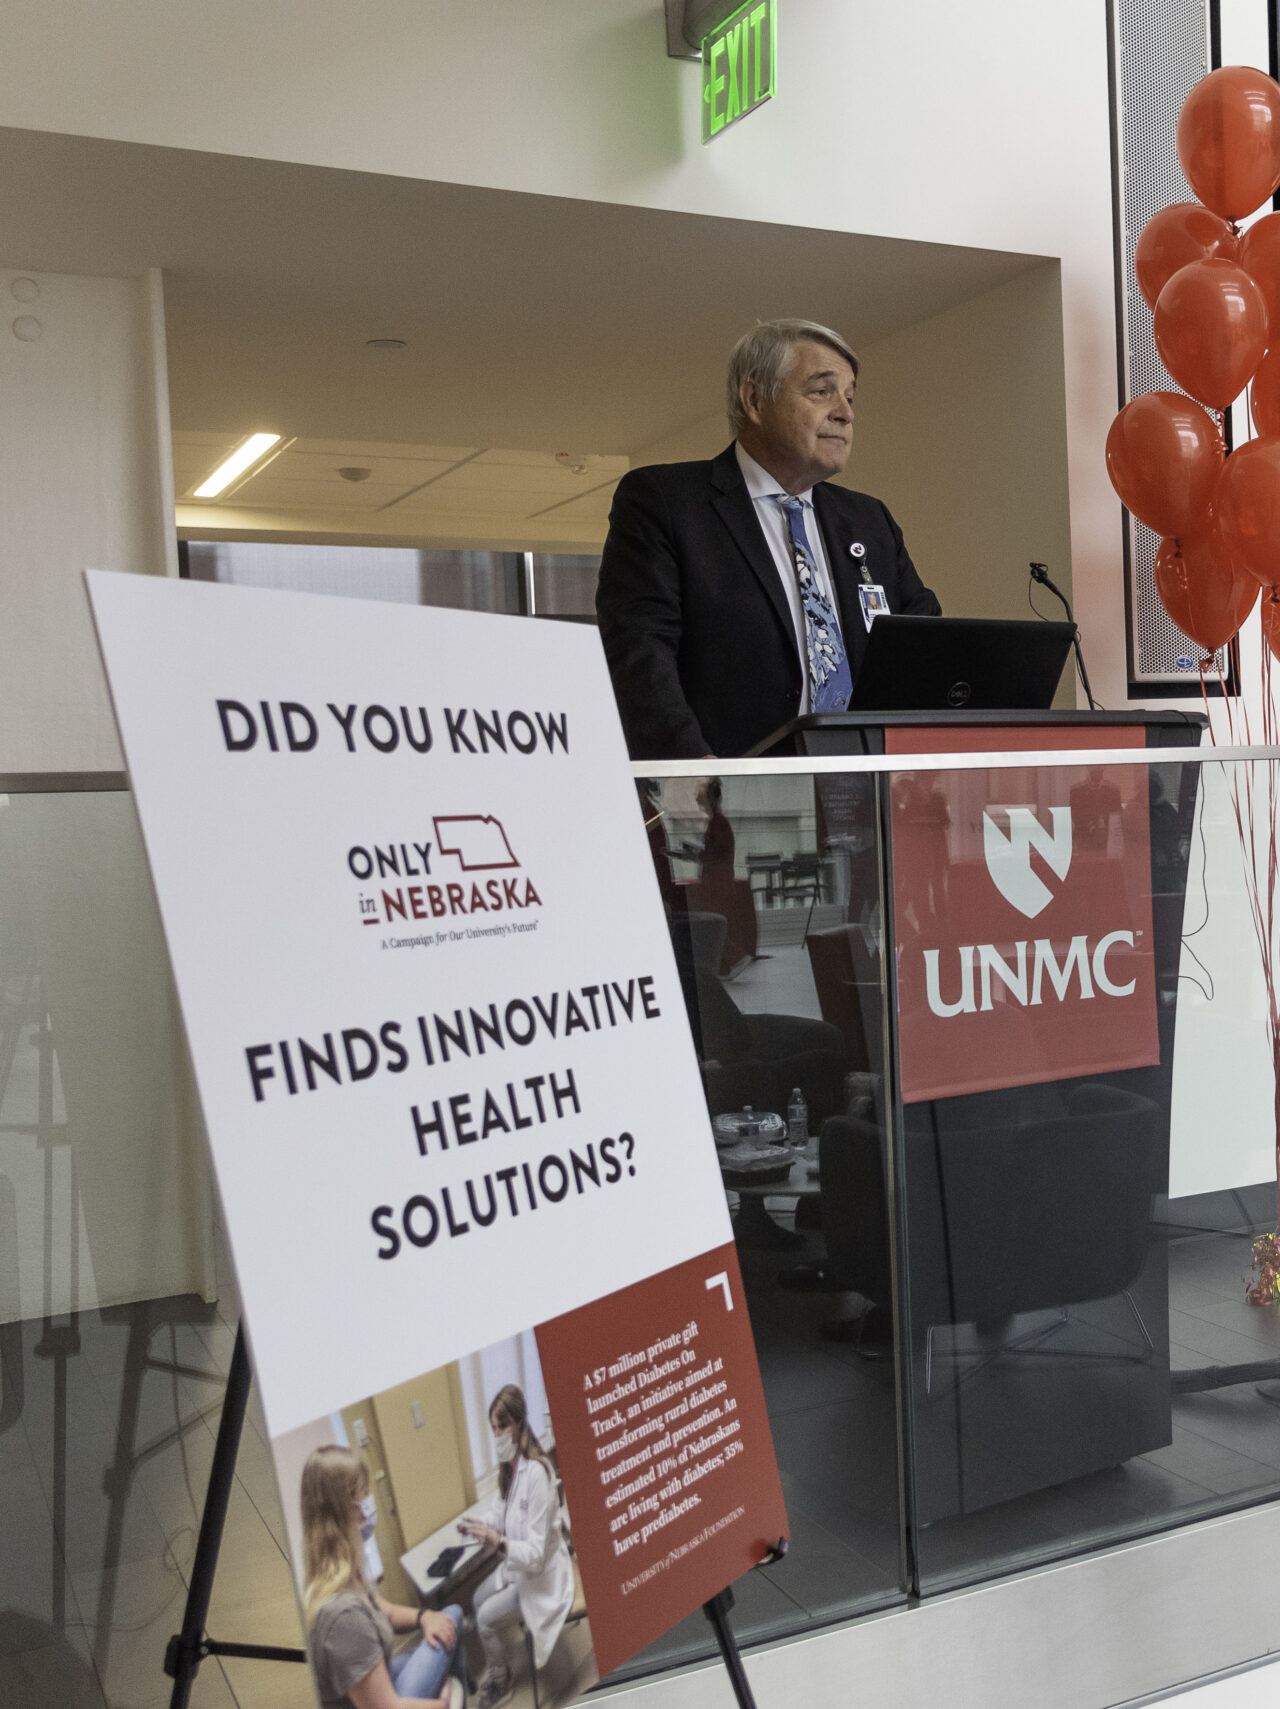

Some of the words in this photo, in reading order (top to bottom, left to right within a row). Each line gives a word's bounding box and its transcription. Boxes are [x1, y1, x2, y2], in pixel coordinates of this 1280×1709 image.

[710, 2, 766, 135] EXIT
[215, 699, 319, 753] DID
[326, 702, 434, 754] YOU
[443, 707, 570, 756] KNOW
[347, 842, 432, 880] ONLY
[359, 893, 377, 914] in
[381, 876, 544, 922] NEBRASKA
[381, 939, 389, 950] A
[389, 933, 434, 950] Campaign
[435, 930, 448, 946] for
[449, 929, 464, 941] Our
[922, 930, 1137, 1018] UNMC
[245, 1020, 410, 1102] FINDS
[417, 975, 662, 1067] INNOVATIVE
[410, 1068, 582, 1156] HEALTH
[370, 1131, 637, 1260] SOLUTIONS?
[584, 1374, 593, 1391] A
[593, 1366, 607, 1386] $7
[608, 1352, 647, 1378] million
[646, 1333, 682, 1363] private
[682, 1320, 699, 1345] gift
[586, 1376, 637, 1414] launched
[637, 1357, 681, 1389] Diabetes
[681, 1349, 697, 1366] On
[591, 1409, 627, 1437] Track,
[627, 1403, 641, 1419] an
[641, 1380, 684, 1411] initiative
[684, 1360, 713, 1388] aimed
[713, 1356, 724, 1373] at
[596, 1415, 665, 1461] transforming
[664, 1396, 689, 1423] rural
[689, 1380, 728, 1409] diabetes
[600, 1445, 652, 1485] treatment
[652, 1431, 672, 1455] and
[672, 1407, 724, 1448] prevention.
[724, 1398, 738, 1414] An
[604, 1465, 656, 1508] estimated
[656, 1455, 677, 1478] 10%
[677, 1444, 688, 1465] of
[688, 1419, 741, 1459] Nebraskans
[609, 1512, 628, 1533] are
[628, 1493, 660, 1521] living
[659, 1476, 682, 1500] with
[724, 1439, 744, 1461] 35%
[613, 1531, 641, 1557] have
[640, 1493, 702, 1544] prediabetes.
